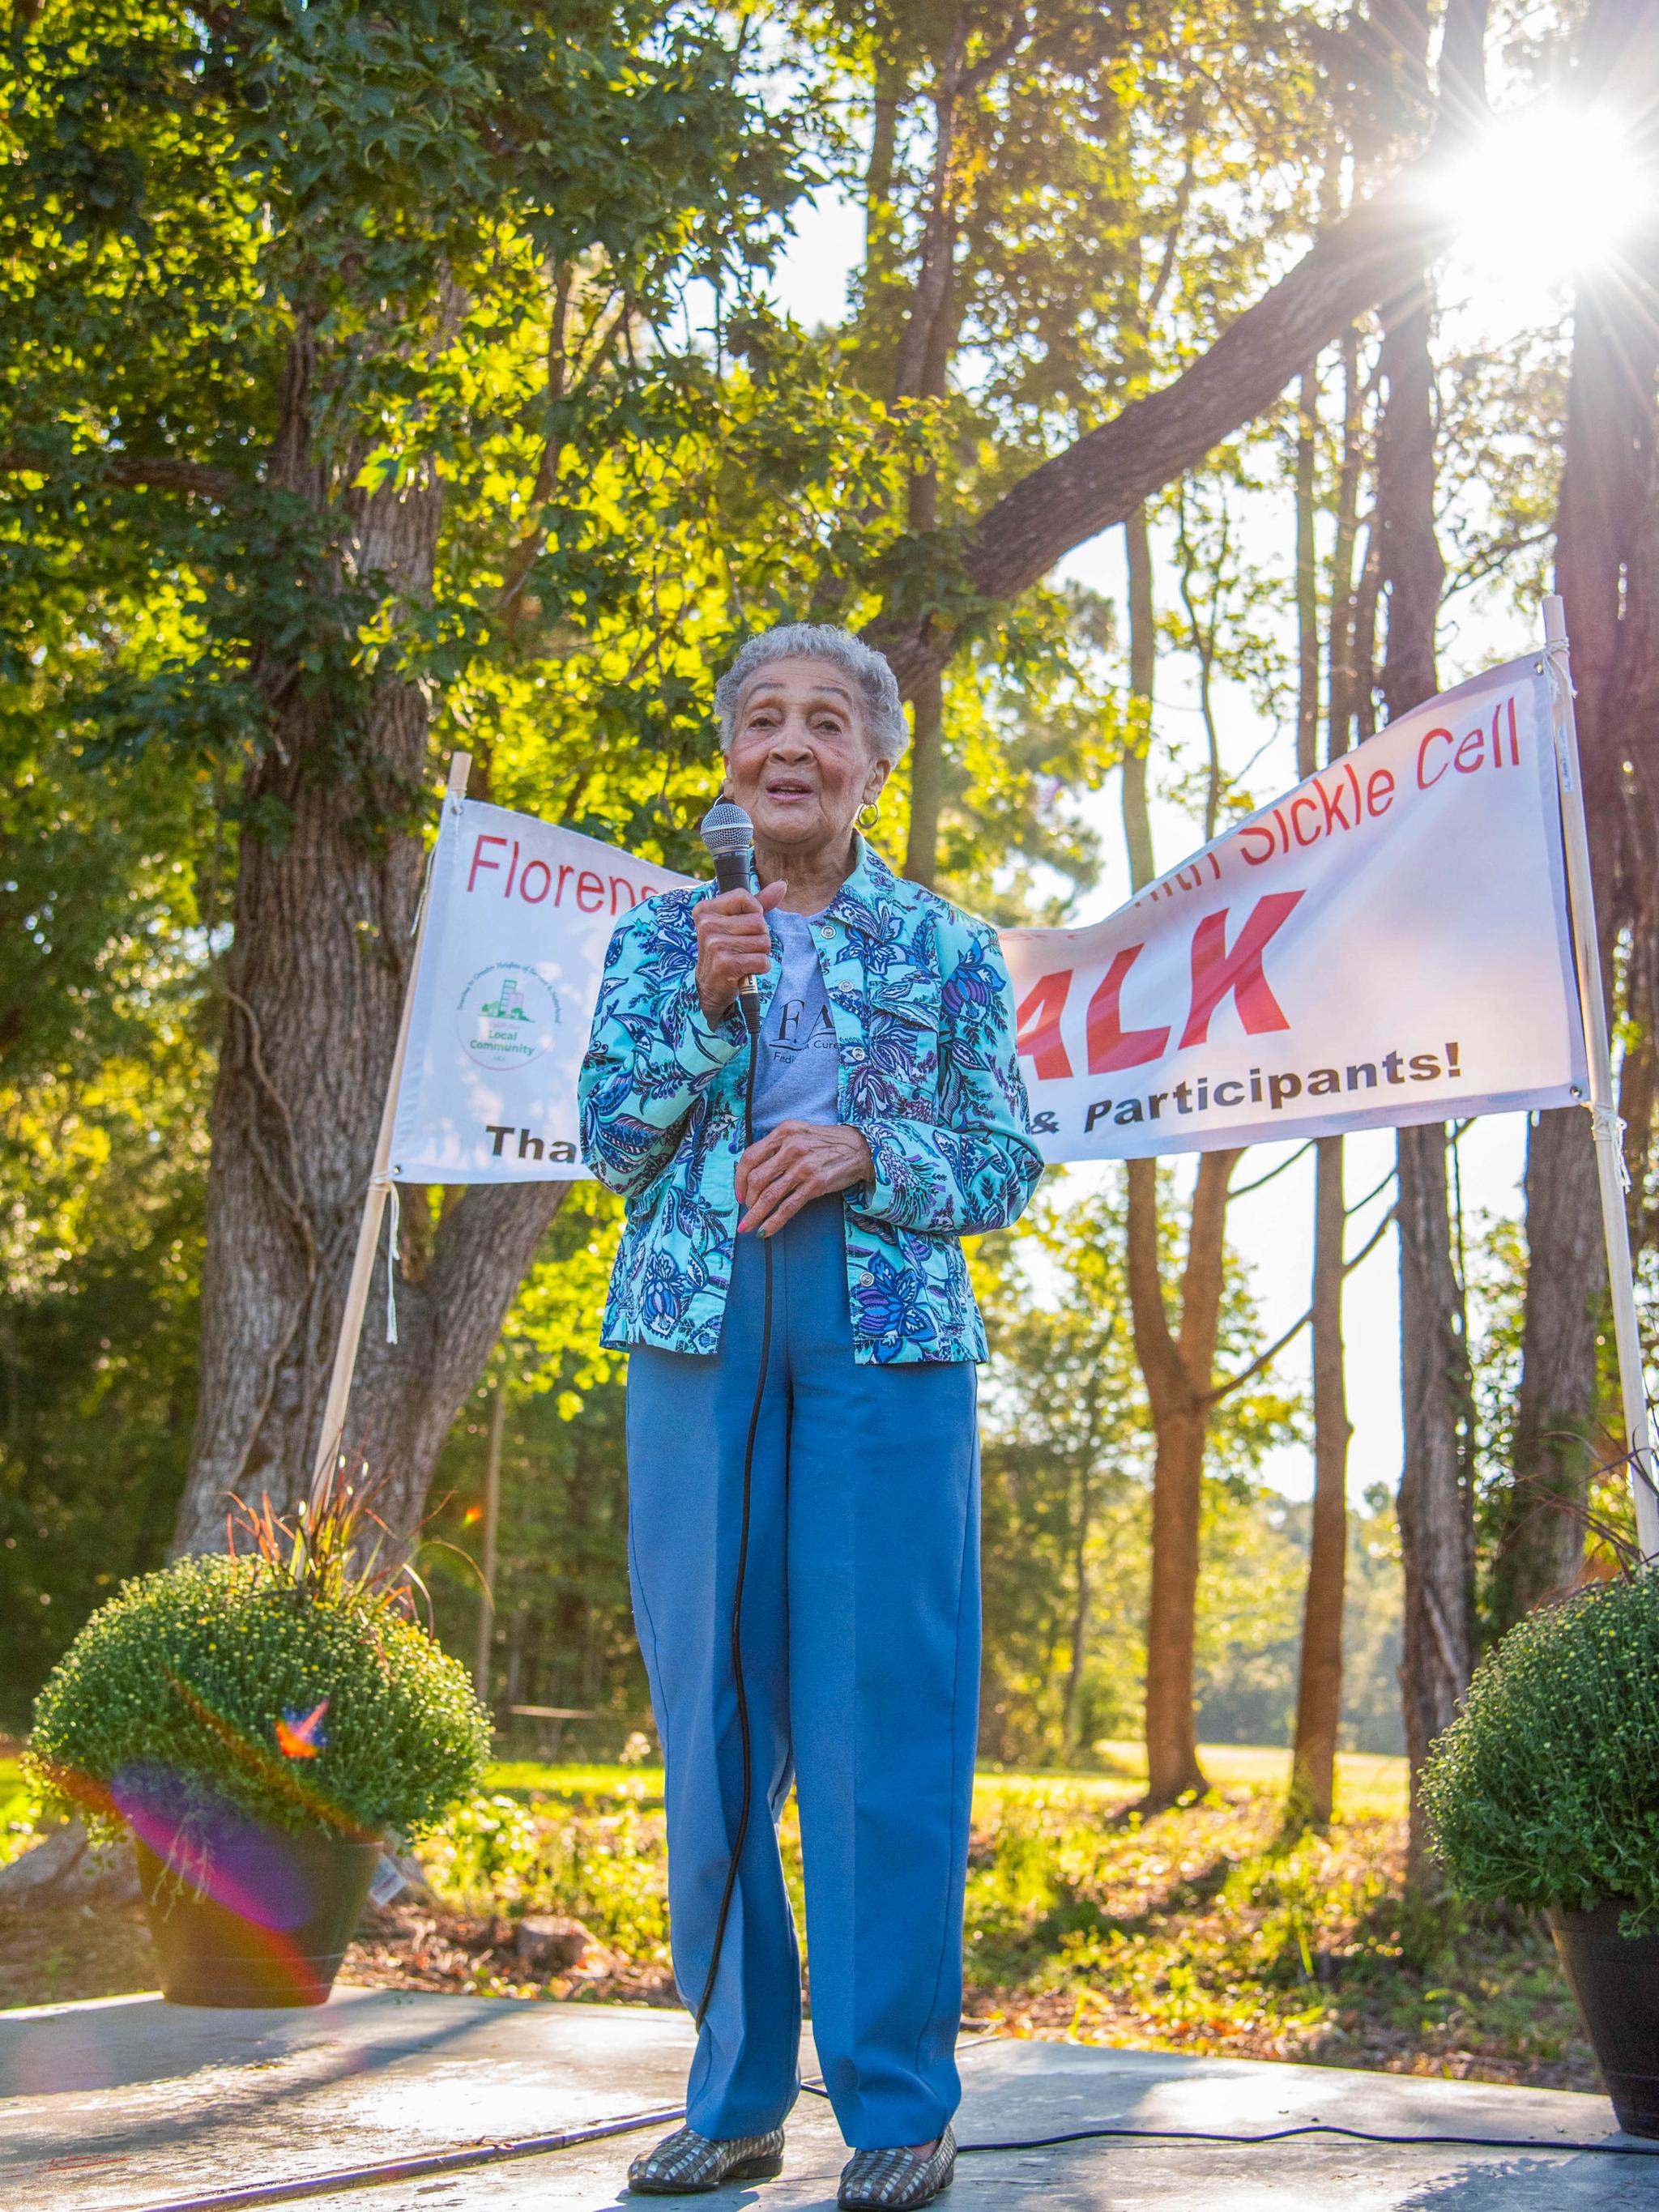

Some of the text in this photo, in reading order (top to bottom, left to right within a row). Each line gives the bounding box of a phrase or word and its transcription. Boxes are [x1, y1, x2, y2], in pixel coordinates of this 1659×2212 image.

[1418, 697, 1520, 791] Cell
[1017, 889, 1307, 1081] ALK
[470, 1039, 535, 1056] Community
[488, 1029, 518, 1042] Local
[1031, 1042, 1461, 1135] & Participants!
[486, 1125, 584, 1164] Tha
